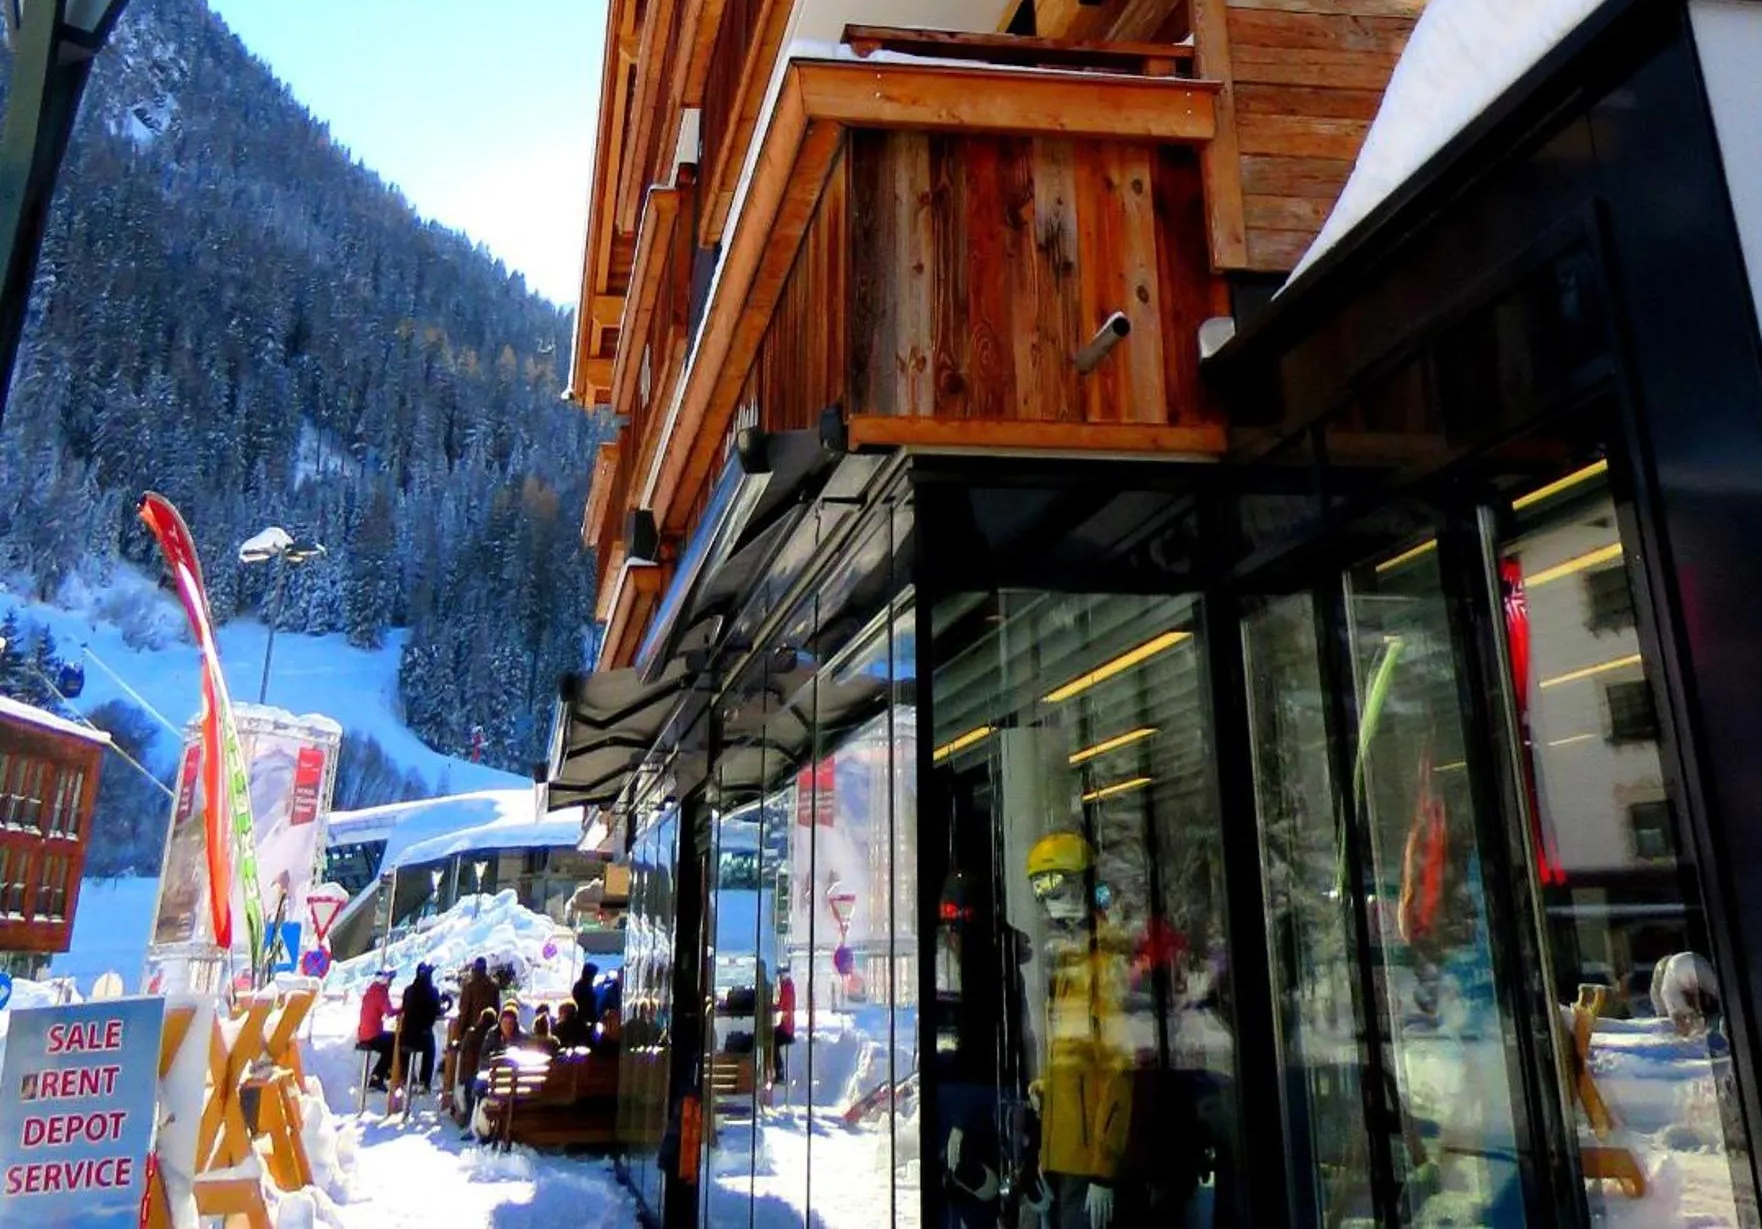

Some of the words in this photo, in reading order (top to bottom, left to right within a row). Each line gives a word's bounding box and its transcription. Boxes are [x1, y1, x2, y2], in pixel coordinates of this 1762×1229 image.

[48, 1020, 122, 1053] SALE
[40, 1066, 120, 1098] RENT
[23, 1111, 126, 1147] DEPOT
[6, 1157, 132, 1195] SERVICE
